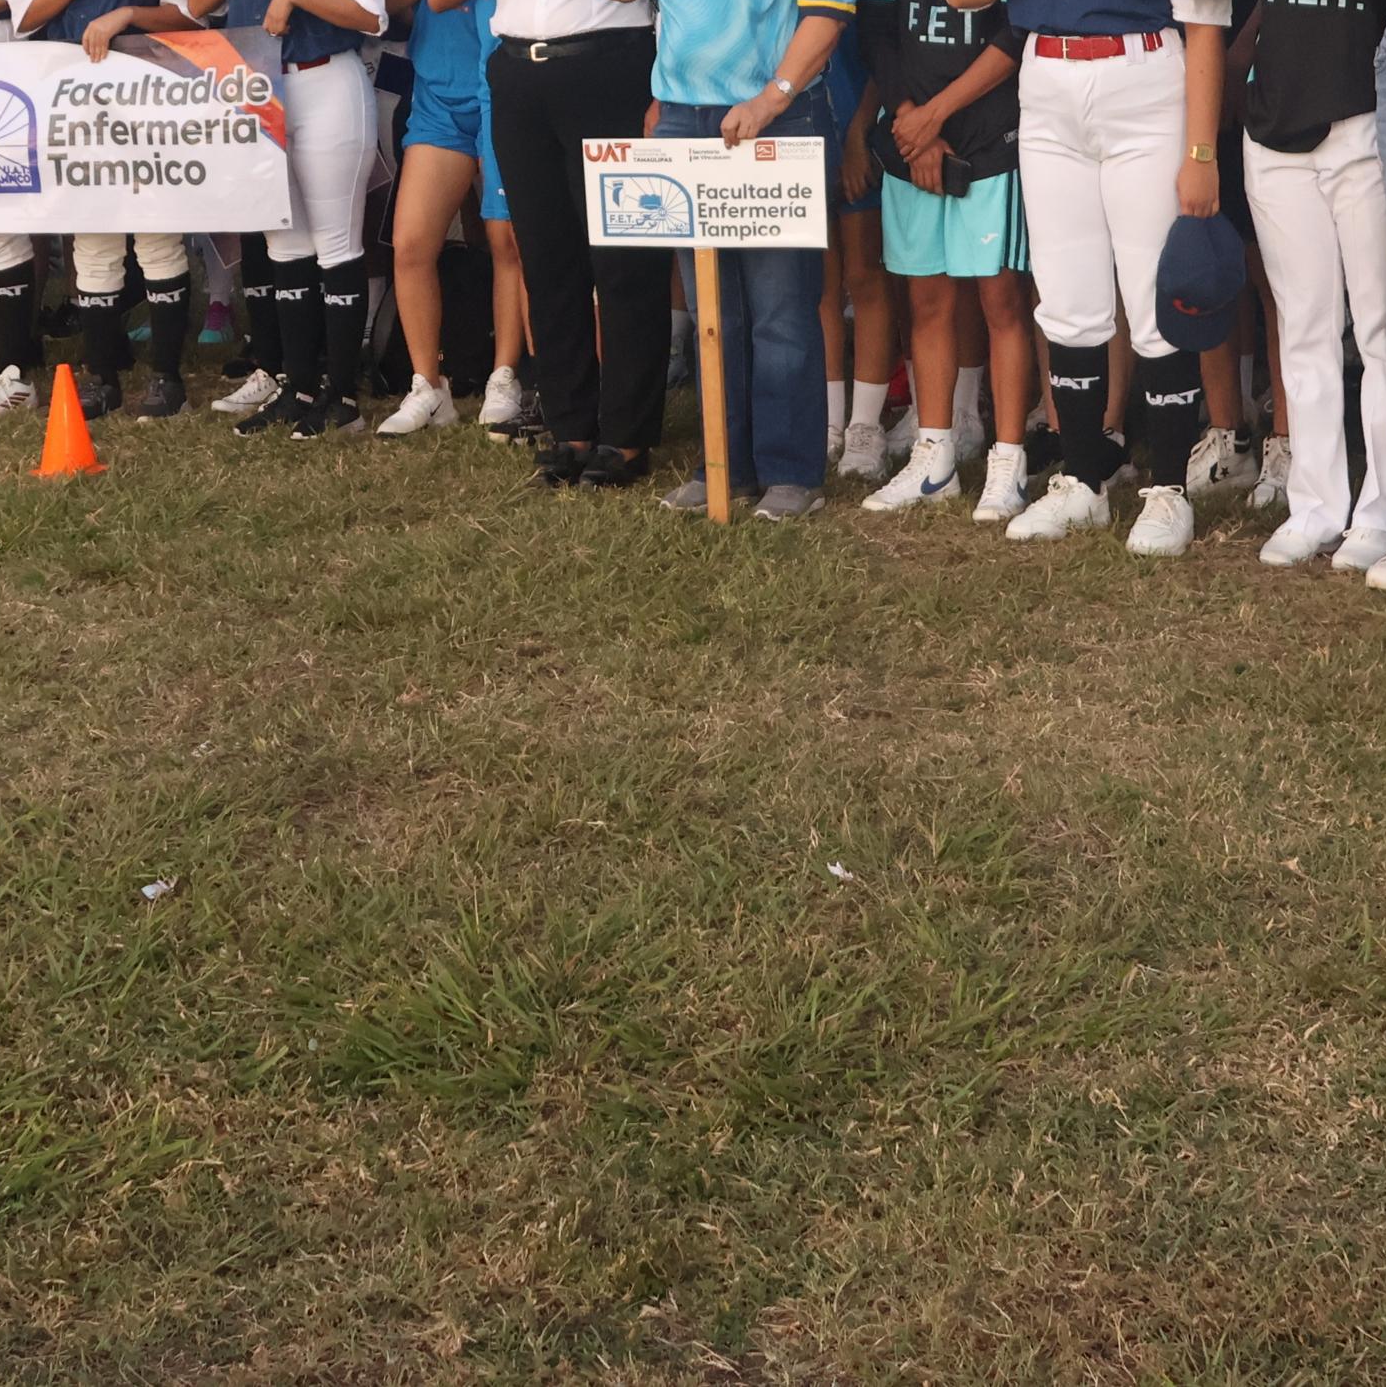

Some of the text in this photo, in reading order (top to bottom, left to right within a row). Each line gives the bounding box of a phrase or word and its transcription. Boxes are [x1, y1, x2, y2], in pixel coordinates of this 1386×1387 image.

[909, 2, 986, 45] F.E.T.
[52, 68, 270, 108] Facultad de
[47, 111, 258, 148] Enfermería
[584, 142, 632, 163] UAT
[47, 154, 207, 194] Tampico
[696, 183, 813, 200] Facultad de
[698, 202, 807, 219] Enfermería
[698, 220, 781, 241] Tampico
[78, 294, 119, 308] UAT
[146, 287, 186, 304] UAT
[1145, 387, 1201, 406] UAT
